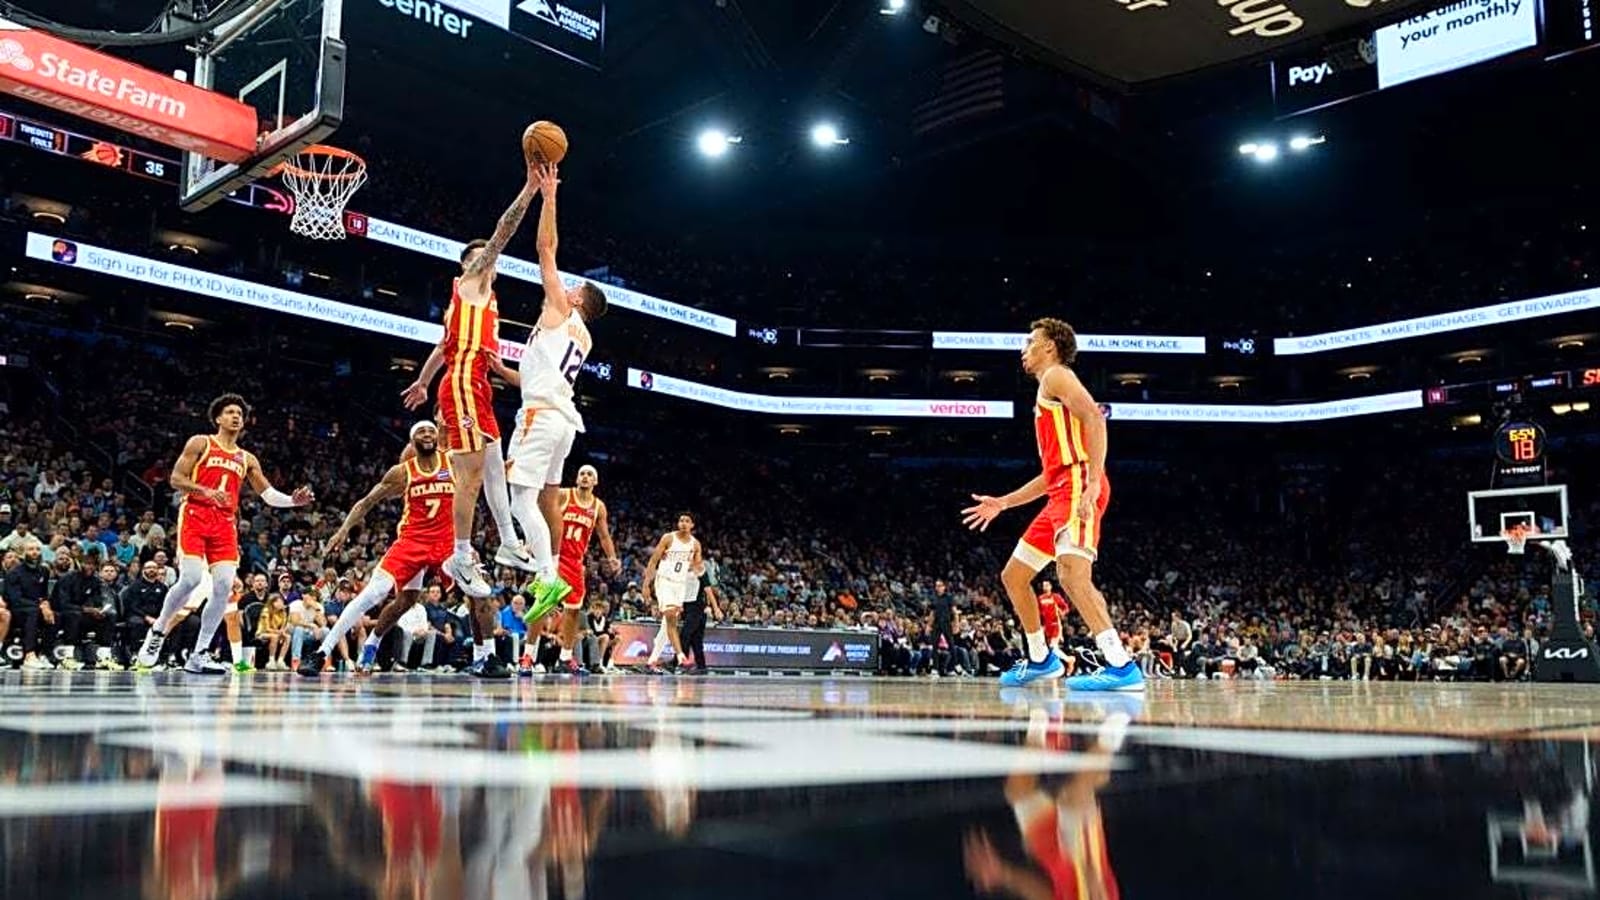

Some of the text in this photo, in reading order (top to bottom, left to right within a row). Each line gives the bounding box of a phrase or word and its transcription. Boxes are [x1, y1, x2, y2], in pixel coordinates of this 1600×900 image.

[1400, 0, 1521, 50] your monthly
[1289, 62, 1333, 86] Pay
[145, 161, 164, 176] 35
[87, 251, 122, 271] Sign
[125, 262, 147, 276] up
[149, 266, 169, 280] for
[1087, 339, 1106, 348] ALL
[1121, 339, 1143, 349] ONE
[560, 341, 583, 385] 12
[929, 402, 987, 415] verizon
[1514, 440, 1535, 460] 18
[1511, 465, 1541, 473] TISSOT
[425, 499, 441, 519] 7
[565, 524, 583, 542] 14
[674, 561, 683, 573] 0
